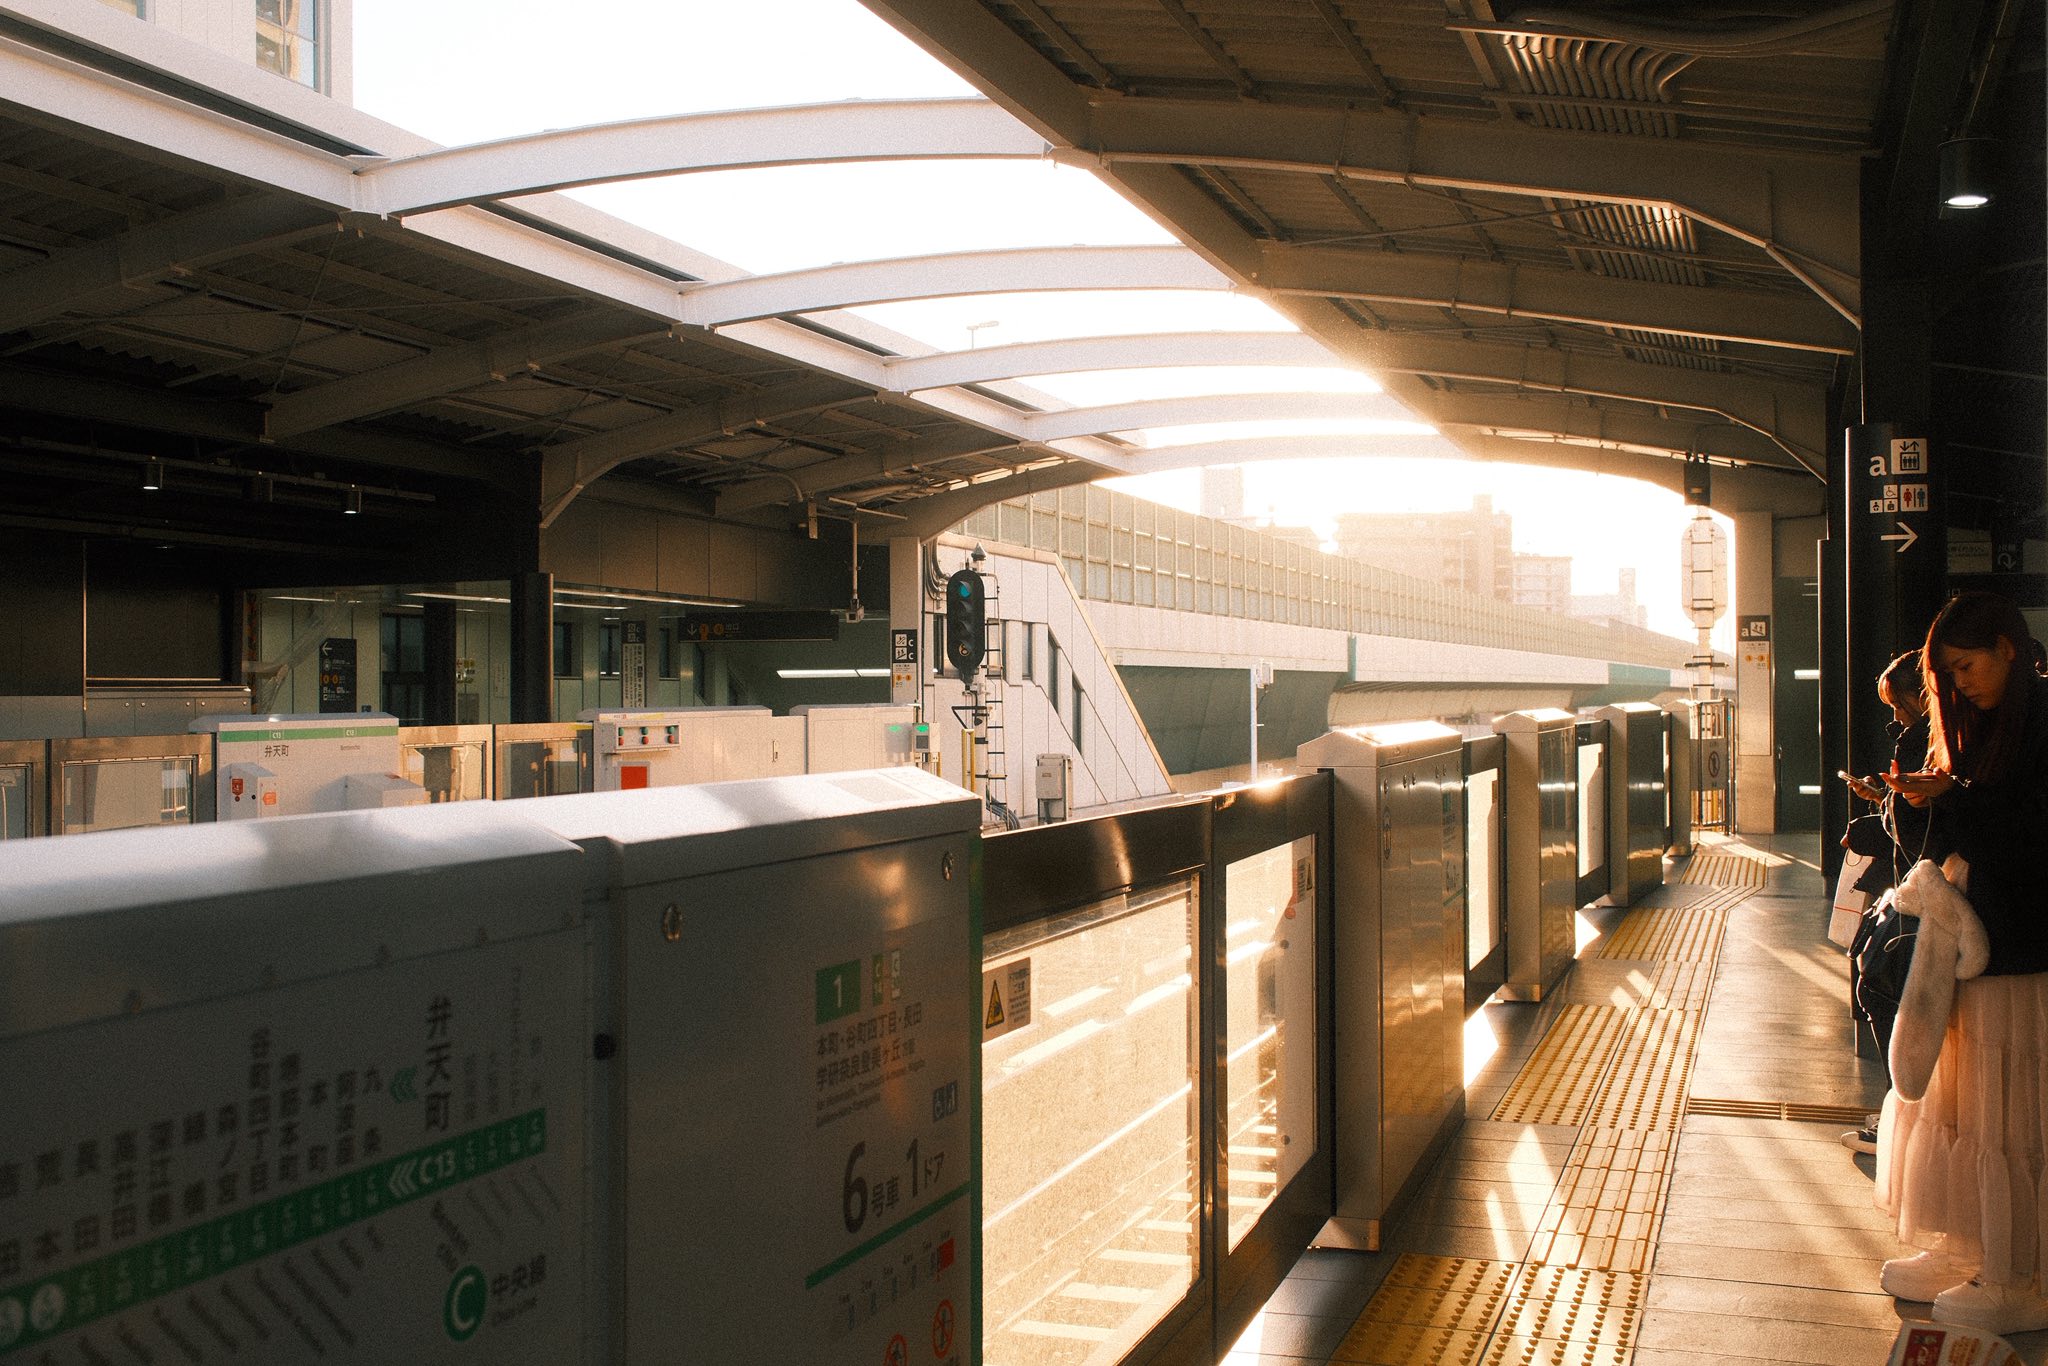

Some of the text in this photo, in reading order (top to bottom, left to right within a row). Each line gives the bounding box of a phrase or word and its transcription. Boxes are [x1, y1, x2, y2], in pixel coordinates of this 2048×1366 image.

[1869, 455, 1887, 477] a
[1741, 628, 1749, 637] a
[264, 745, 289, 757] 弁天町
[833, 974, 842, 1009] 1
[425, 995, 452, 1132] 弁天町
[419, 1149, 456, 1186] C13
[843, 1138, 945, 1235] 6号車 1ドア
[491, 1253, 546, 1304] 中央線
[451, 1275, 475, 1331] C
